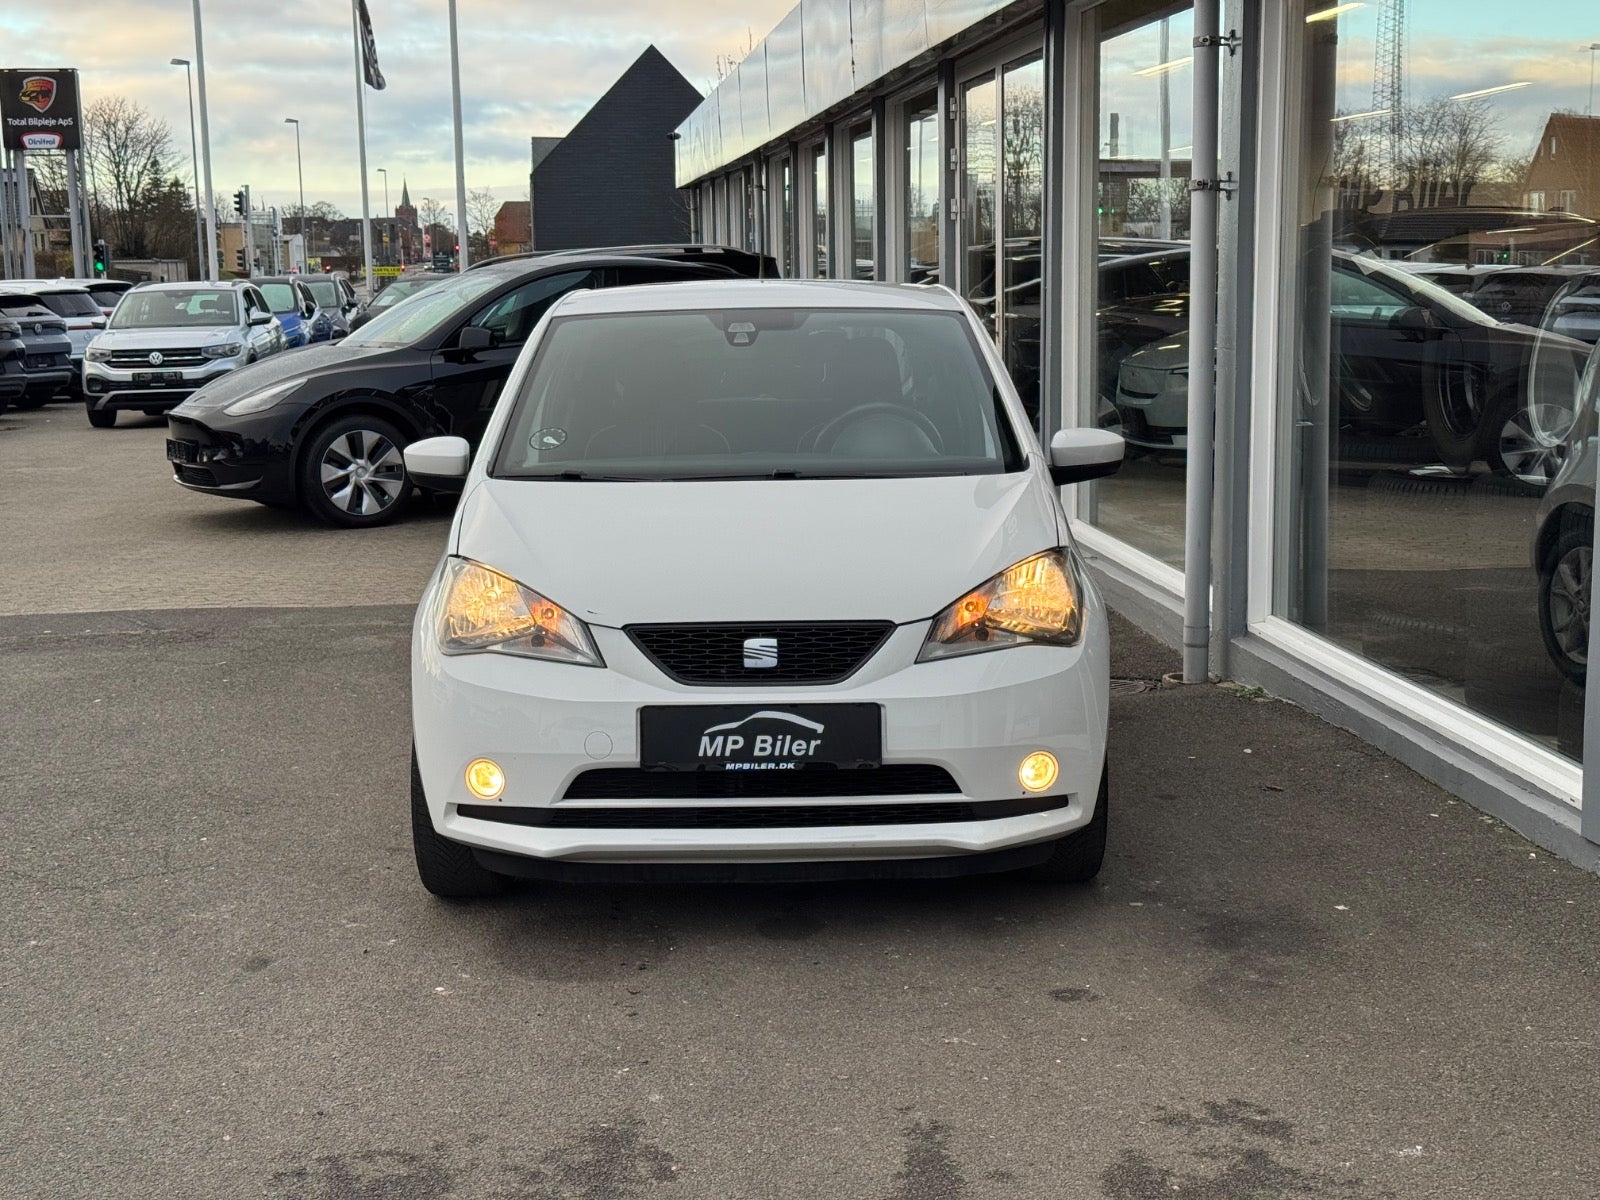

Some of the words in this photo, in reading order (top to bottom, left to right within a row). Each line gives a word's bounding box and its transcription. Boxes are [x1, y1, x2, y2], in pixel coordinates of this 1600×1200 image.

[7, 117, 27, 126] Total
[28, 117, 57, 127] Bilpleje
[57, 117, 74, 127] ApS
[27, 138, 56, 146] Dinitrol
[698, 735, 745, 757] MP
[753, 735, 822, 757] Biler
[725, 762, 796, 770] MPBILER.DK
